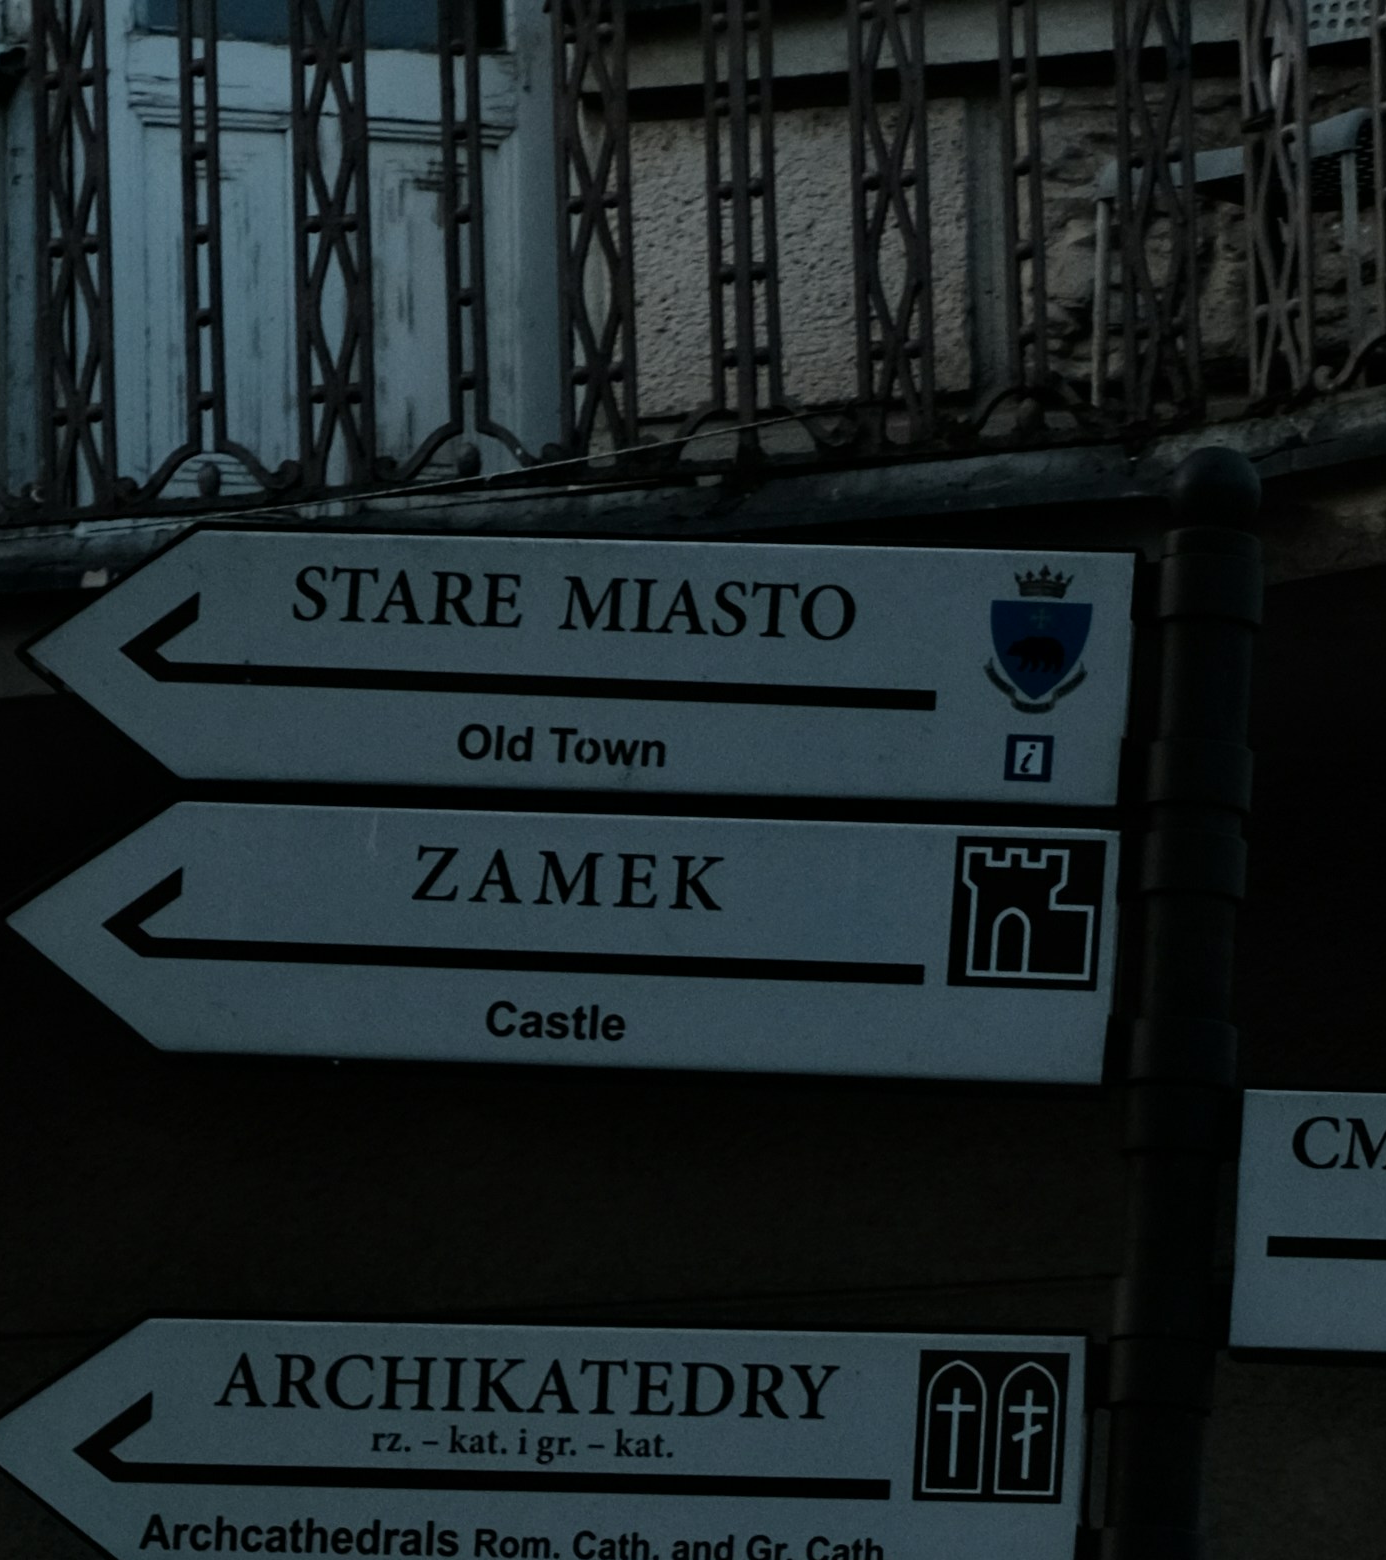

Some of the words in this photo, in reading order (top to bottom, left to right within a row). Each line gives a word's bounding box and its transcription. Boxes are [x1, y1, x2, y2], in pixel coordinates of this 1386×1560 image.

[292, 565, 523, 629] STARE
[558, 575, 857, 641] MIASTO
[457, 723, 534, 762] Old
[549, 727, 666, 768] Town
[411, 844, 725, 912] ZAMEK
[485, 1000, 626, 1042] Castle
[213, 1352, 841, 1420] ARCHIKATEDRY
[371, 1432, 411, 1453] rz.
[448, 1424, 507, 1455] kat.
[517, 1428, 528, 1455] i
[535, 1436, 577, 1465] gr.
[614, 1428, 674, 1459] kat.
[138, 1513, 460, 1558] Archcathedrals
[473, 1528, 560, 1560] Rom.
